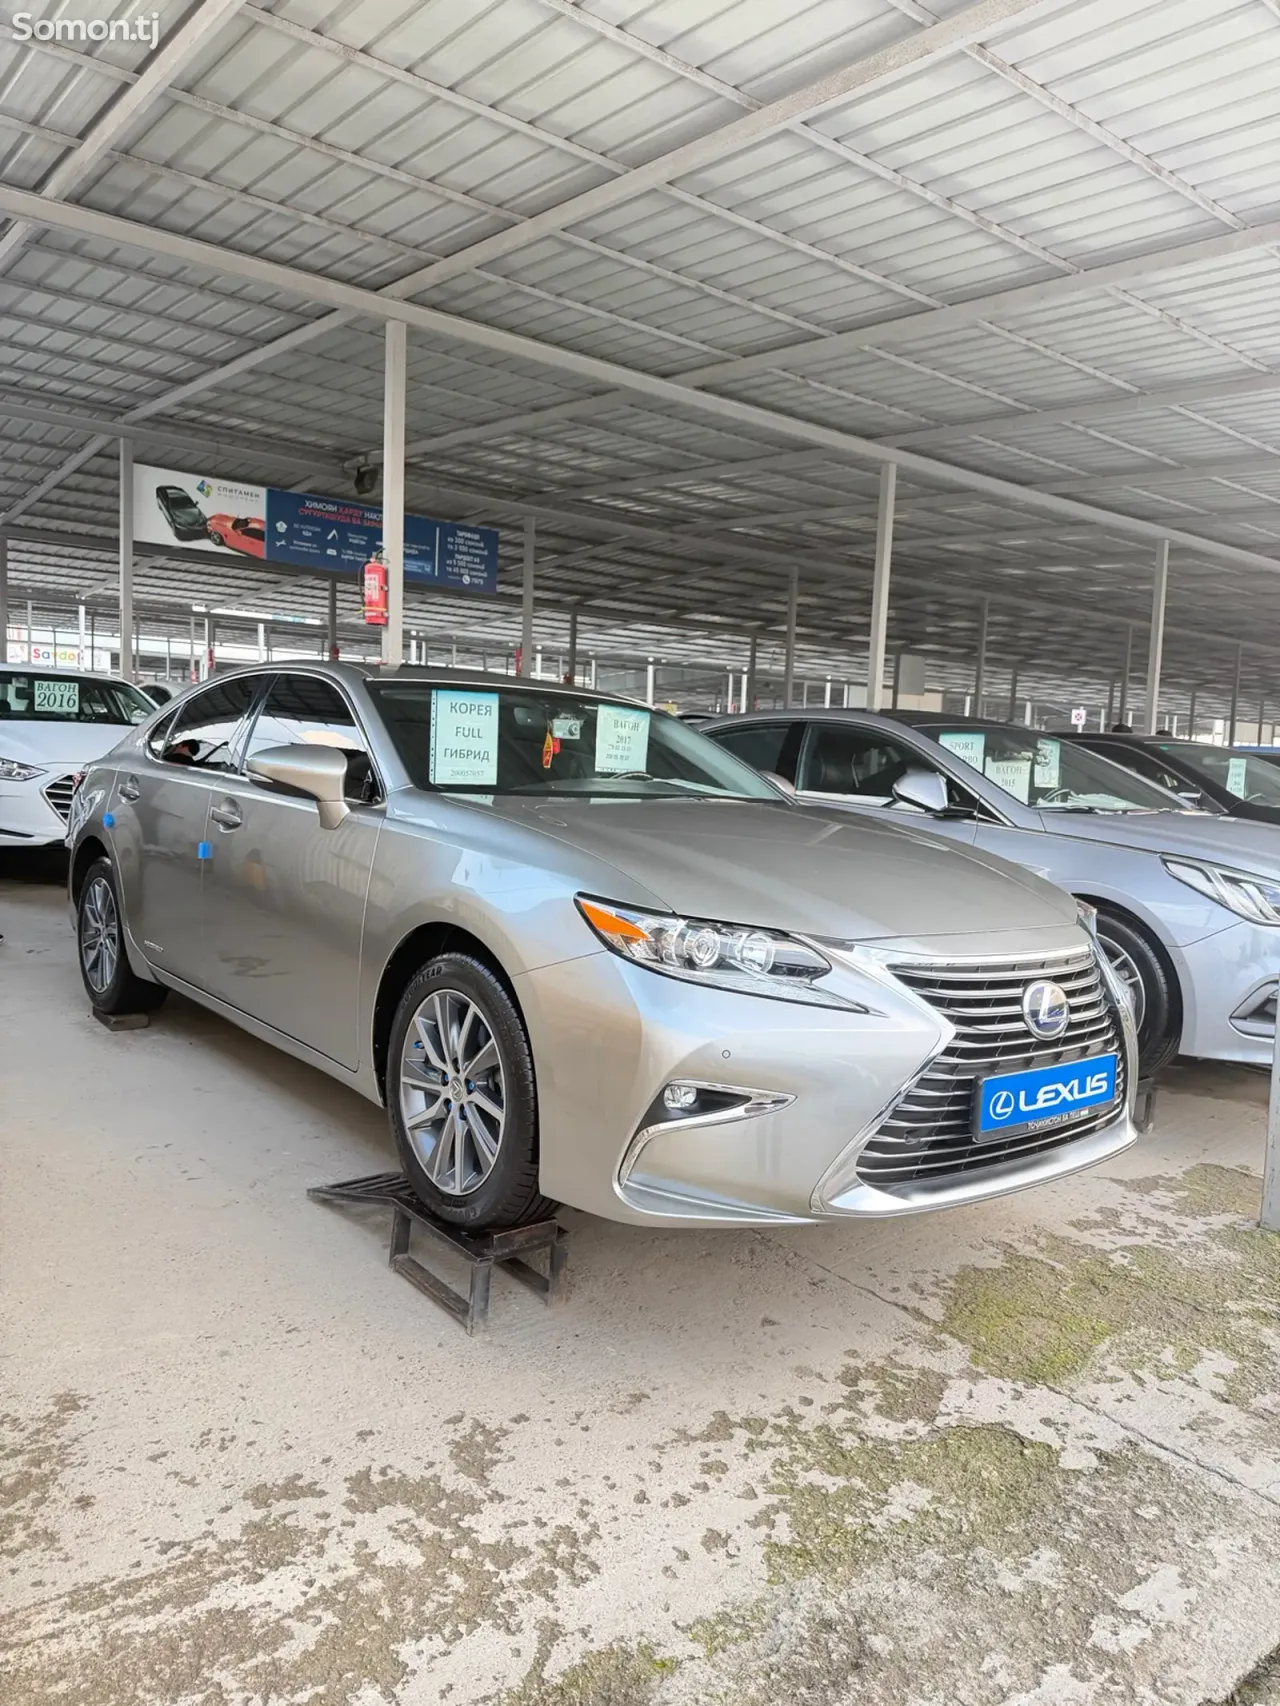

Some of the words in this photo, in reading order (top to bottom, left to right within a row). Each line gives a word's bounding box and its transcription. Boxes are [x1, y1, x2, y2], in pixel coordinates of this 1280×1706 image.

[217, 486, 260, 498] СПИТАМЕН
[37, 682, 77, 693] ВАГОН
[37, 693, 77, 709] 2016
[450, 702, 492, 716] КОРЕЯ
[455, 727, 483, 739] FULL
[616, 734, 631, 745] 2017
[950, 741, 975, 751] SPORT
[443, 747, 490, 762] ГИБРИД
[995, 766, 1022, 775] ВАГОН
[1019, 1072, 1108, 1111] LEXUS
